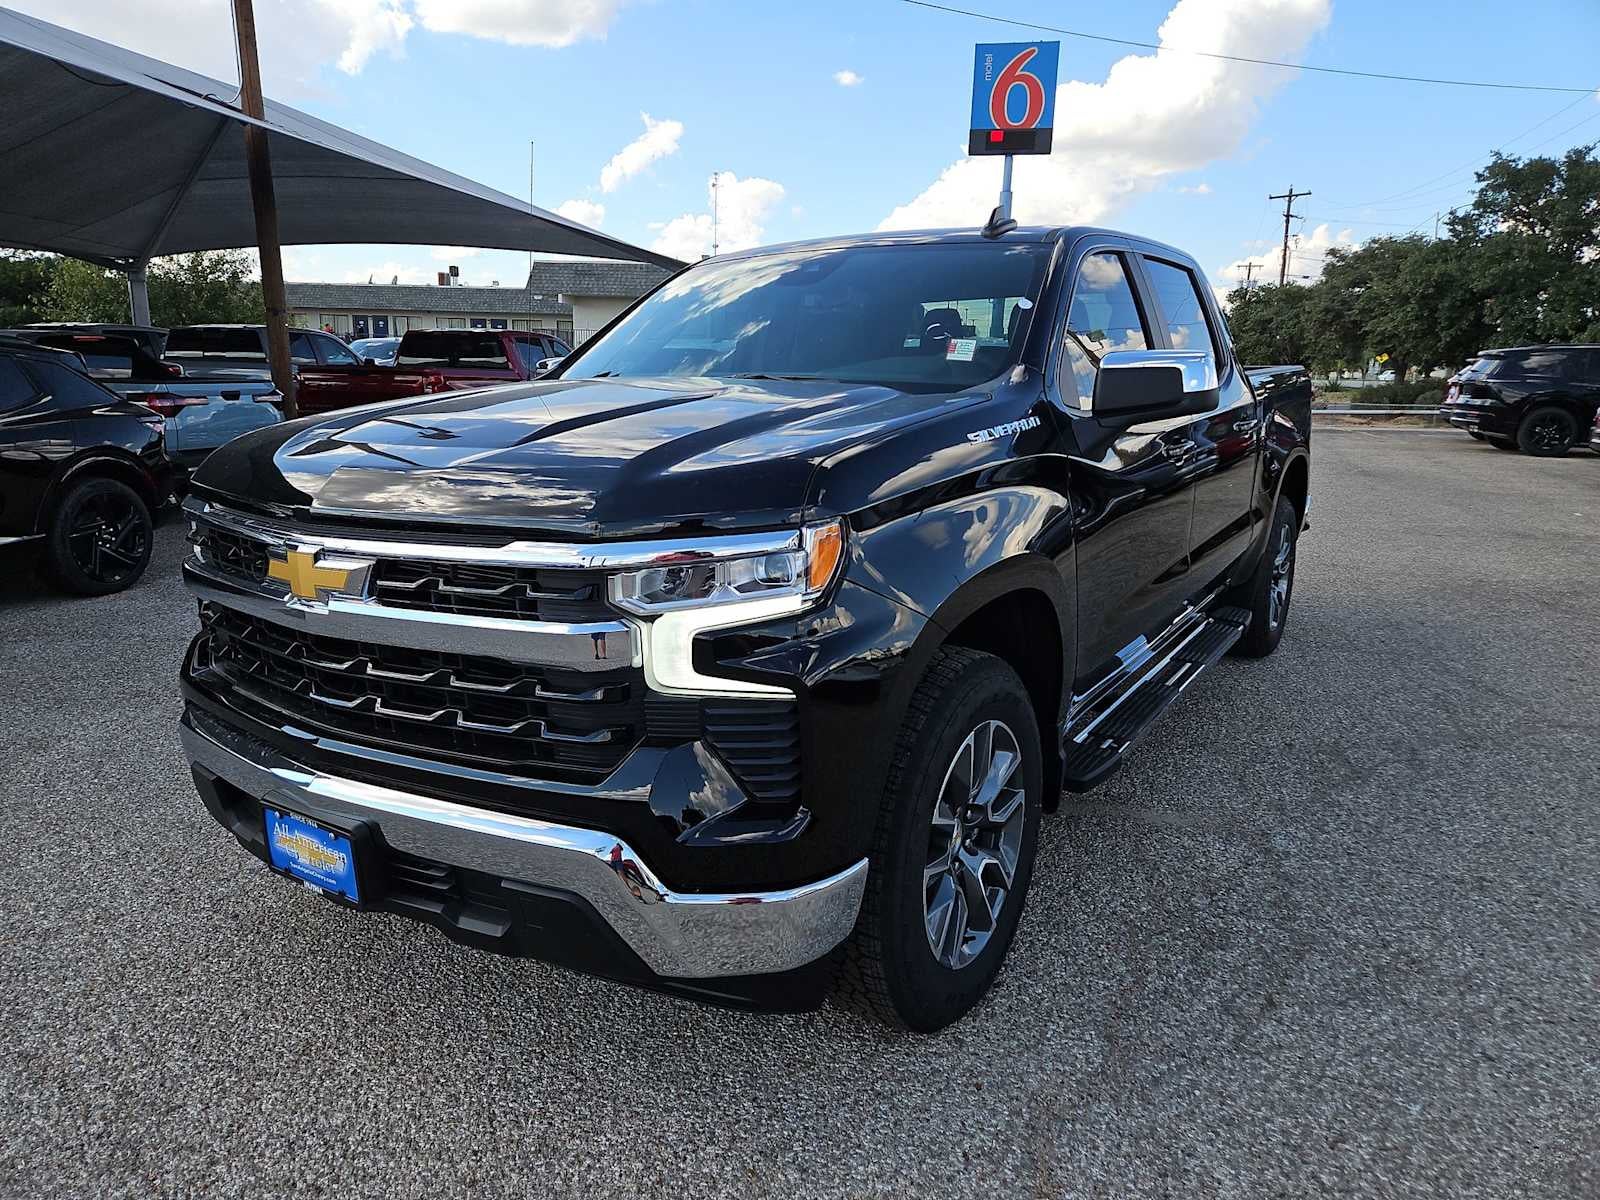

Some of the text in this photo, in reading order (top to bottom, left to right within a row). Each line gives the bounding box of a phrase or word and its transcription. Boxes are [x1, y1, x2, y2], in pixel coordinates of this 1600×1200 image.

[984, 53, 993, 80] motel
[989, 47, 1045, 129] 6
[966, 415, 1041, 444] SILVERADO
[273, 821, 347, 864] All American
